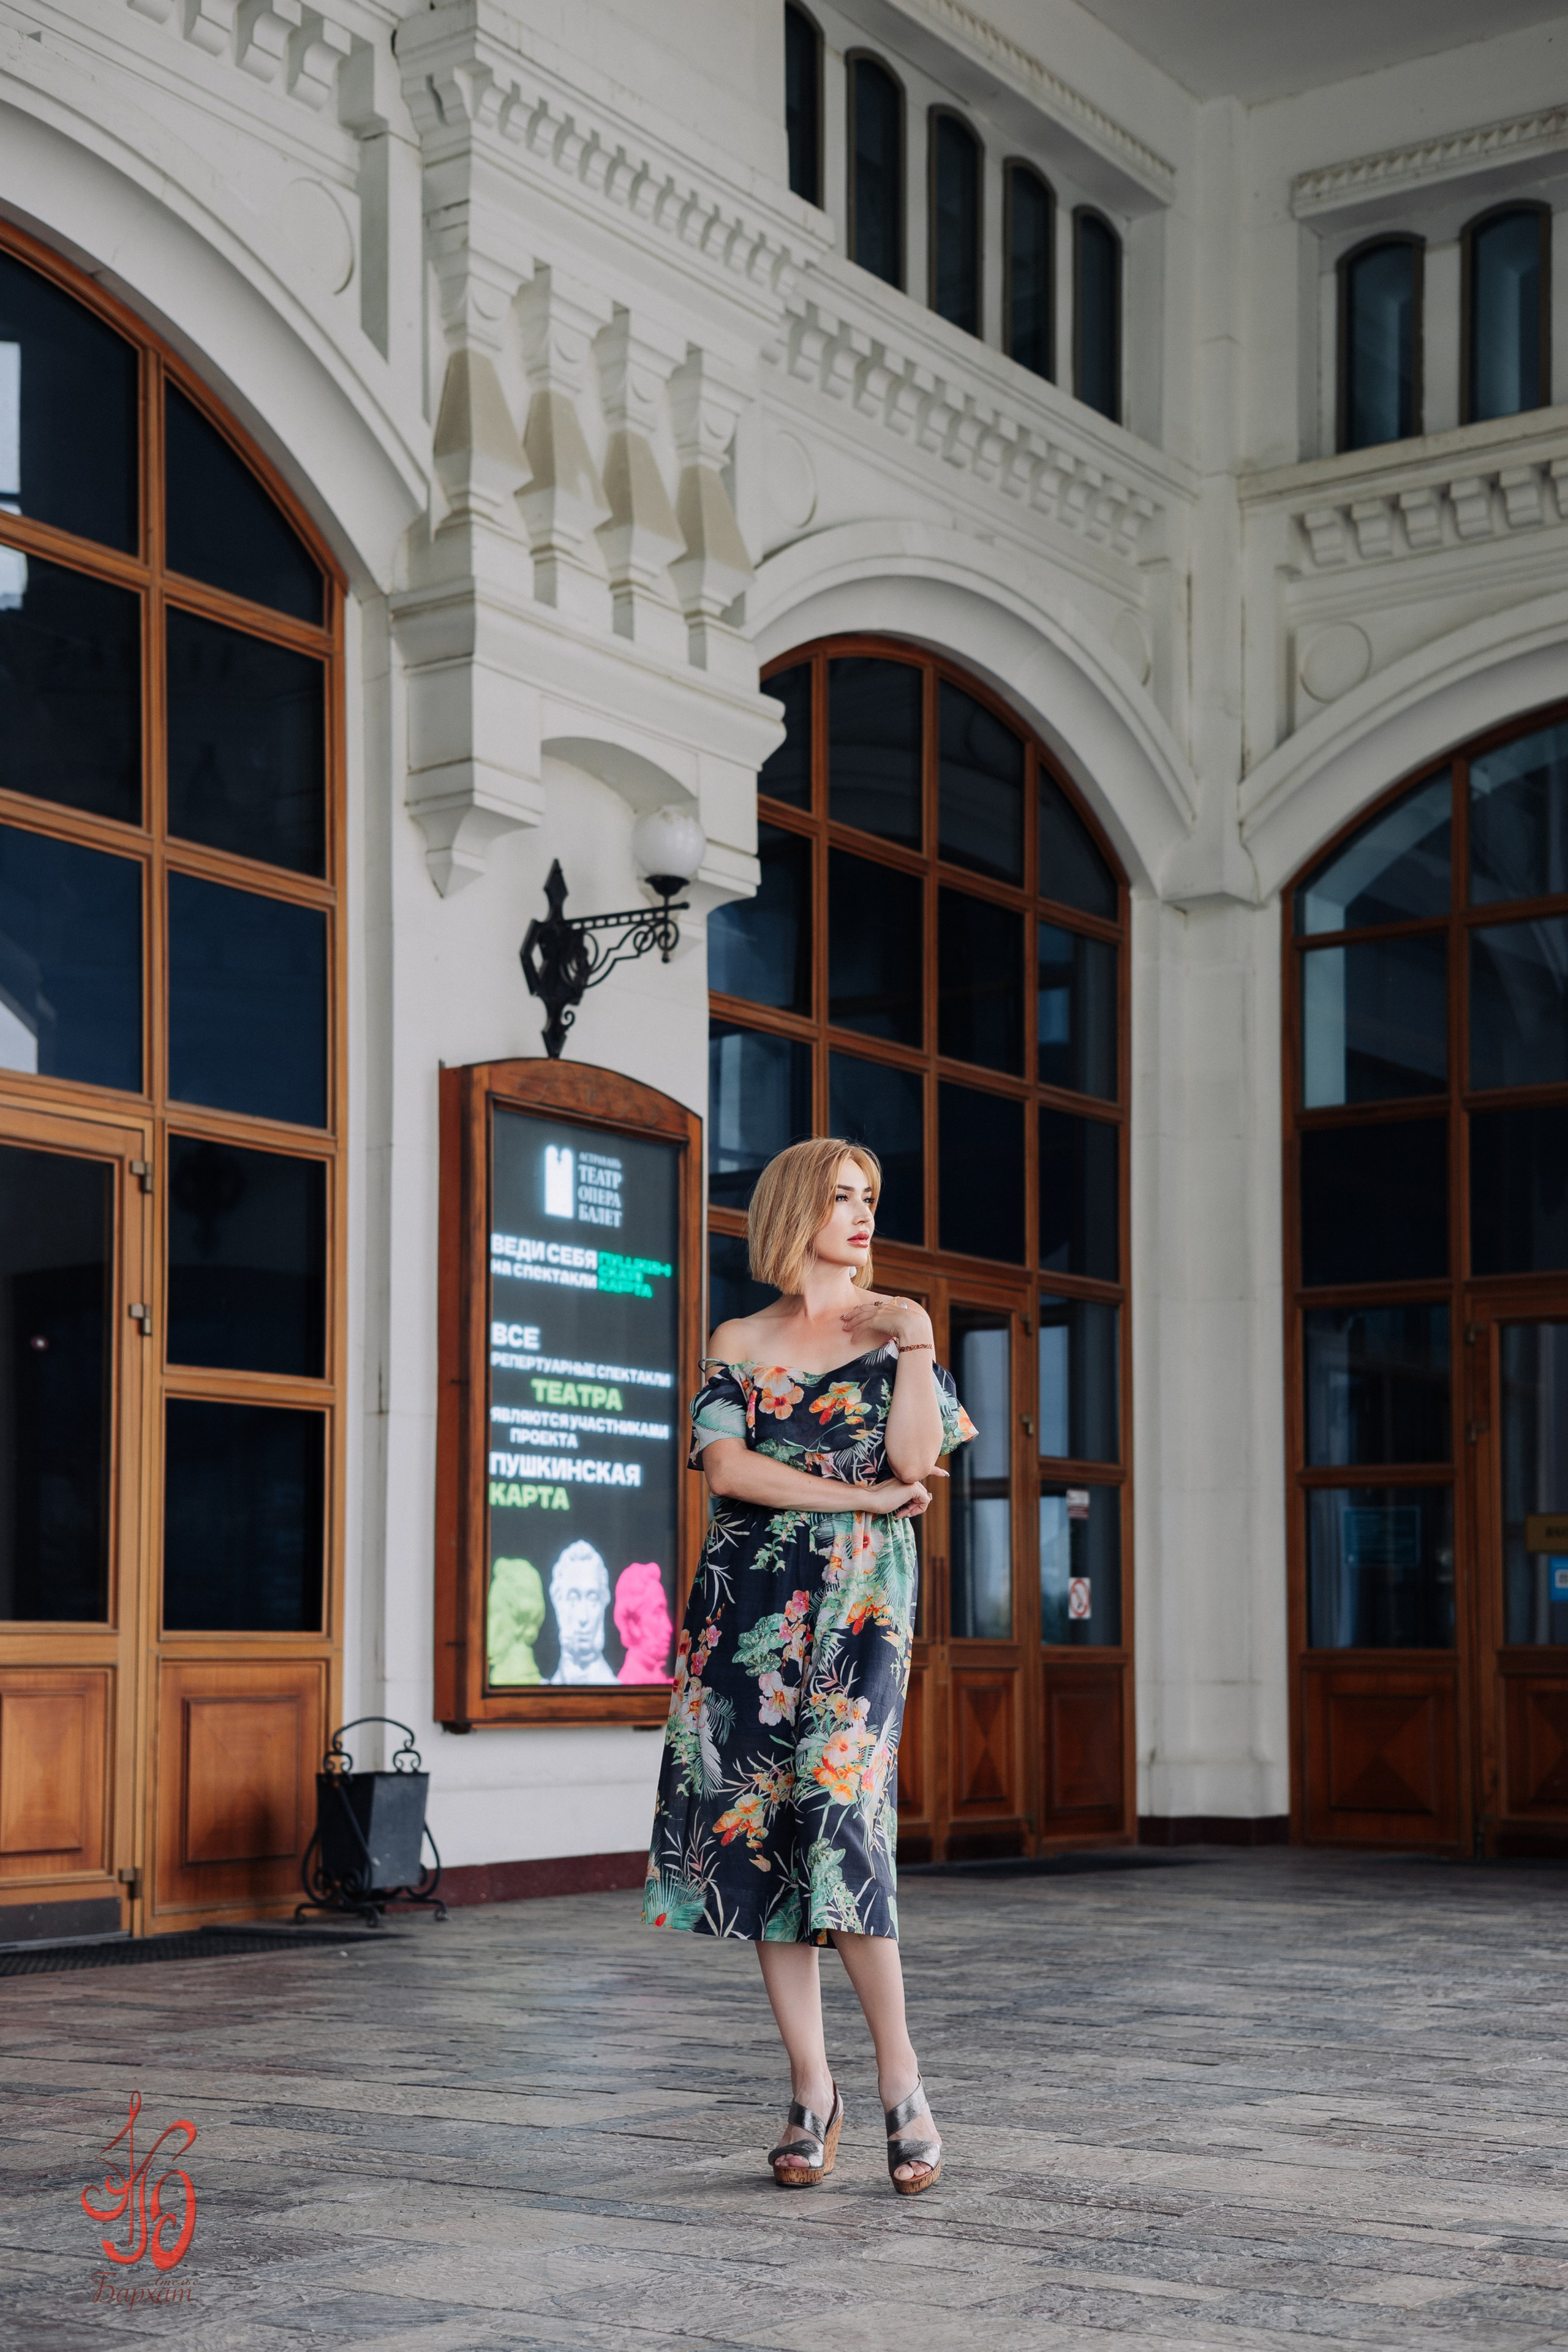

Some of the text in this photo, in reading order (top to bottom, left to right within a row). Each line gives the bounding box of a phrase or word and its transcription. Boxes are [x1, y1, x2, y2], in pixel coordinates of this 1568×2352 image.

[578, 1164, 622, 1189] ТЕАТР
[578, 1185, 622, 1208] ОПЕРА
[578, 1203, 622, 1227] БАЛЕТ
[491, 1233, 598, 1270] ВЕДИ СЕБЯ
[491, 1322, 540, 1351] ВСЕ
[491, 1351, 671, 1388] РЕПЕРТУАРНЫЕ СПЕКТАКЛИ
[530, 1378, 623, 1411] ТЕАТРА
[490, 1406, 669, 1440] ЯВЛЯЮТСЯ УЧАСТНИКАМИ
[510, 1427, 579, 1449] ПРОЕКТА
[489, 1451, 641, 1487] ПУШКИНСКАЯ
[489, 1482, 570, 1510] КАРТА
